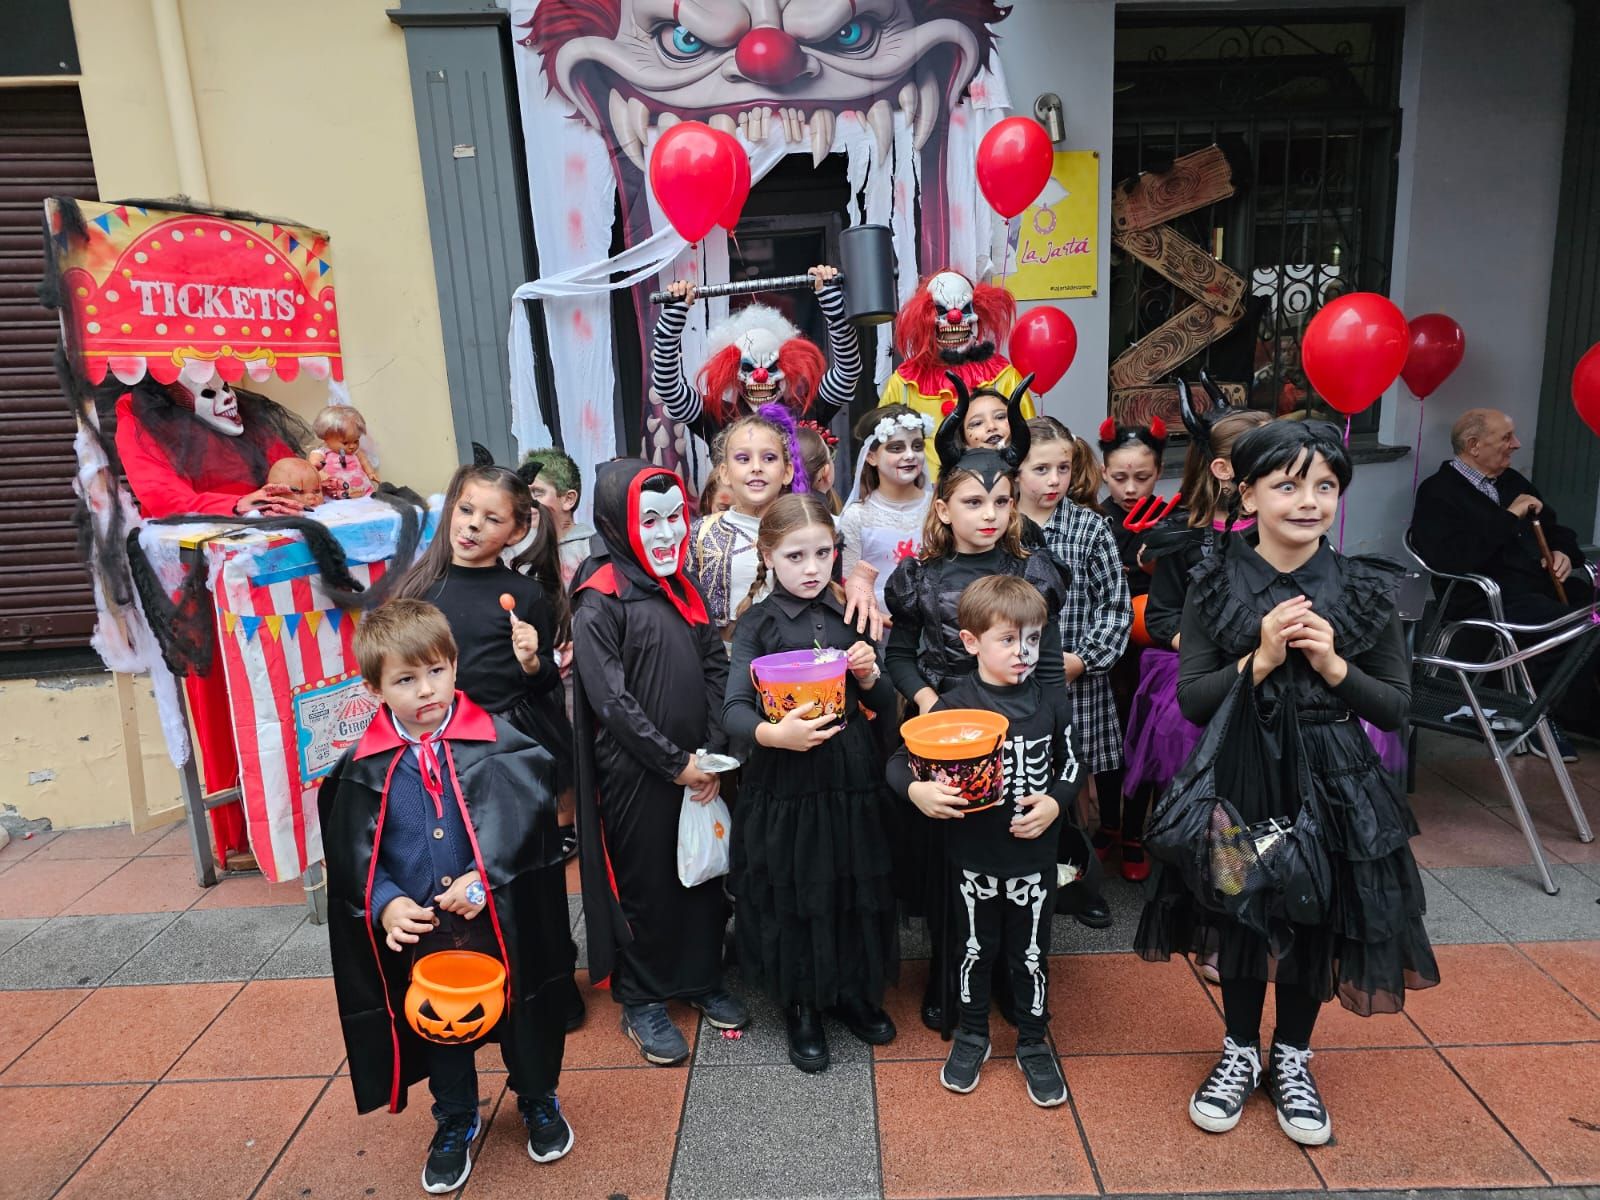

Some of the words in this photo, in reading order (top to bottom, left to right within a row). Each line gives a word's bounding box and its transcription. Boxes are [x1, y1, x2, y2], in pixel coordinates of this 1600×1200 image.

[1021, 240, 1038, 263] La
[130, 279, 296, 321] TICKETS
[311, 702, 326, 713] 23
